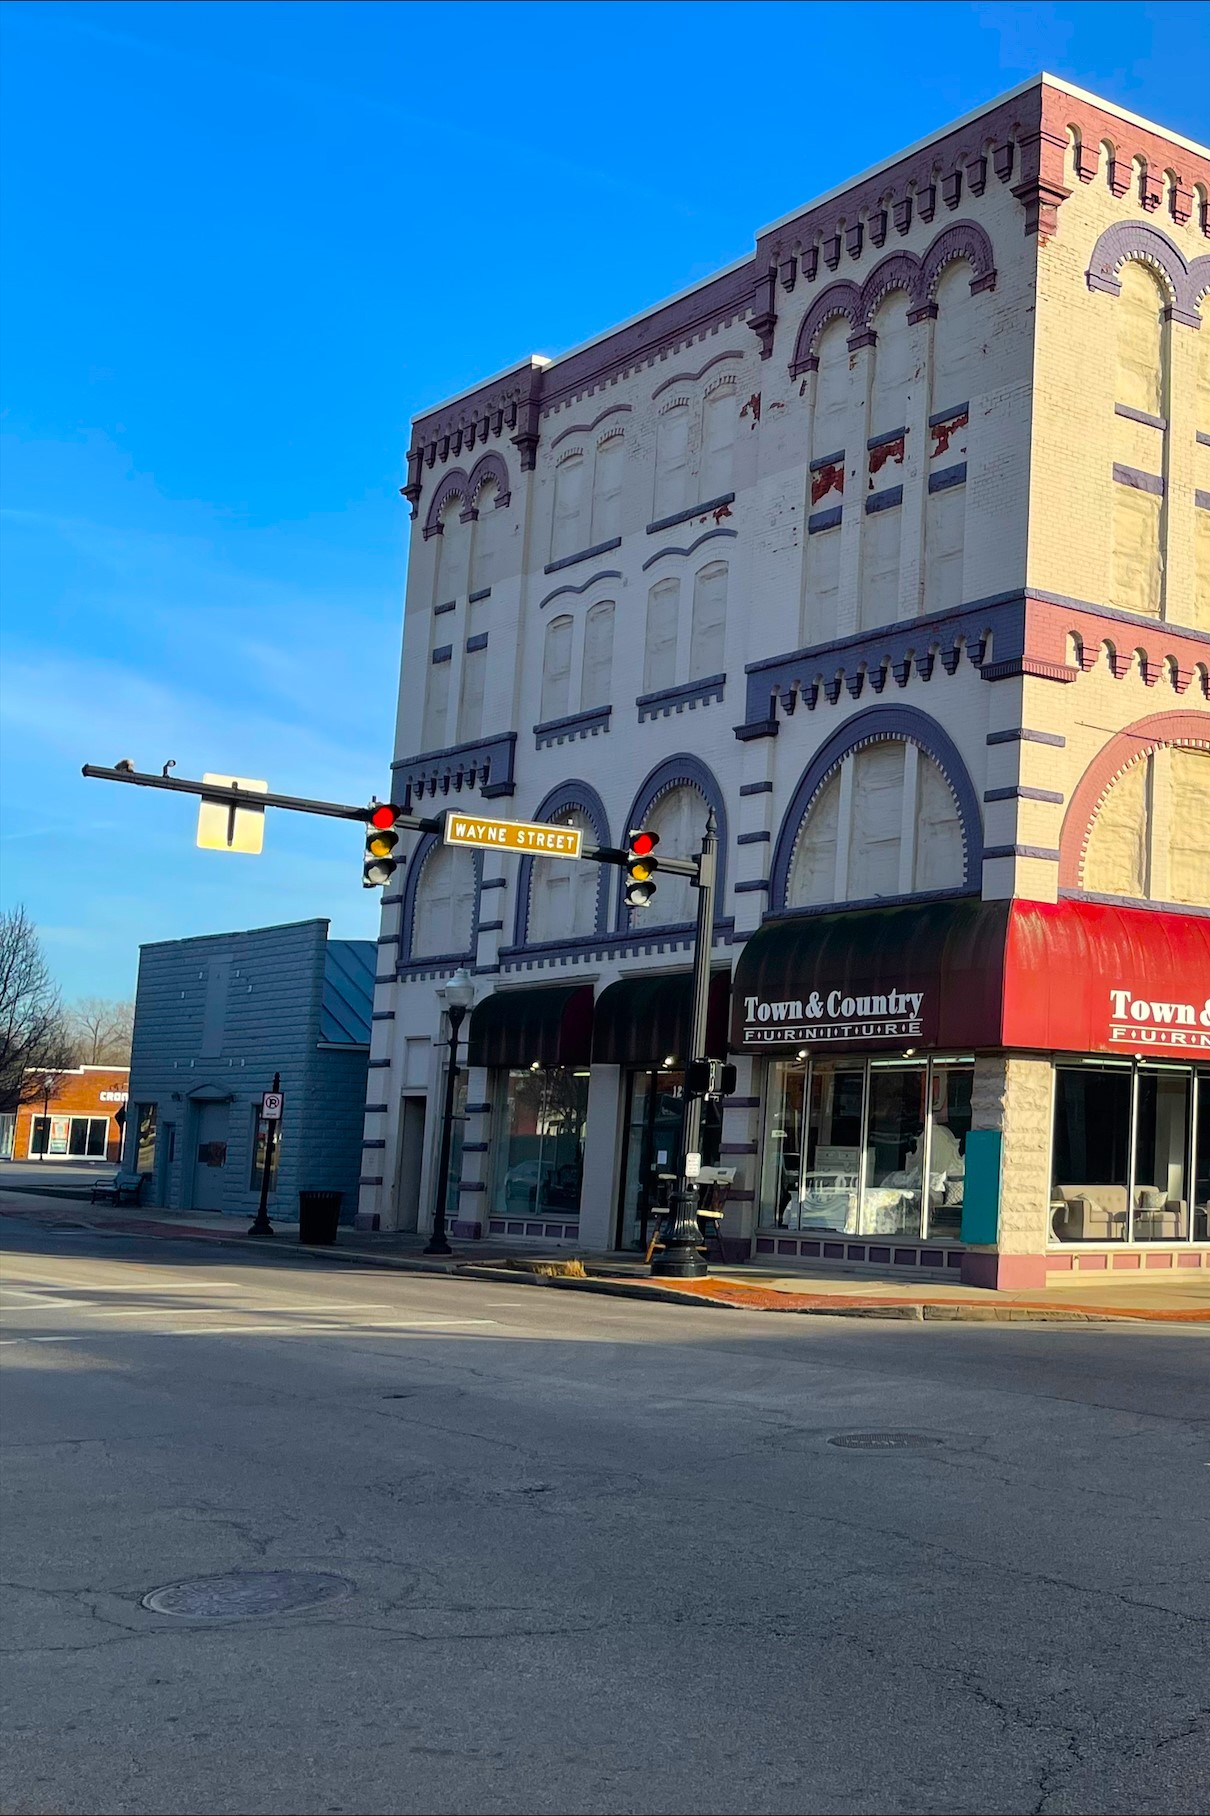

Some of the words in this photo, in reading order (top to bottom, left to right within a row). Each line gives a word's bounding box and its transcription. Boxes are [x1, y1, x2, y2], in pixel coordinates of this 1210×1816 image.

[455, 822, 507, 842] WAYNE
[517, 830, 575, 850] STREET
[744, 996, 803, 1023] Town
[805, 991, 824, 1019] &
[827, 988, 924, 1019] Country
[1109, 989, 1196, 1026] Town
